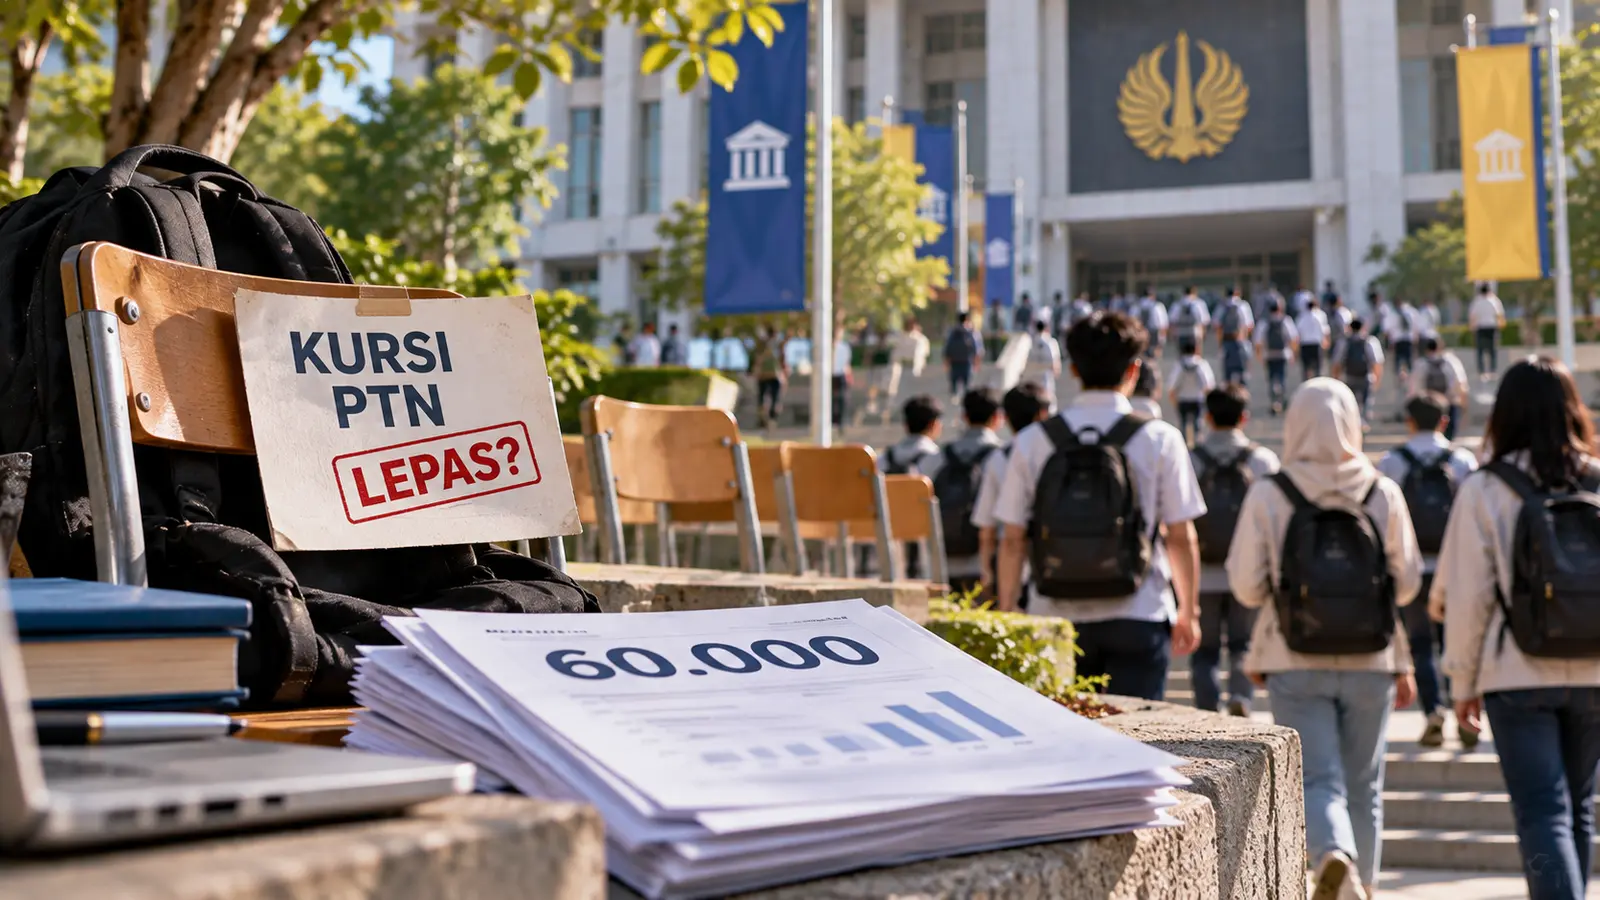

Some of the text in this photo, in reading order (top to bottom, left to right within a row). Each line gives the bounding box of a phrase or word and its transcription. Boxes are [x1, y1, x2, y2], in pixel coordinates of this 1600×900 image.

[289, 331, 453, 375] KURSI
[332, 384, 446, 429] PTN
[351, 436, 521, 508] LEPAS?
[545, 635, 880, 681] 60.000
